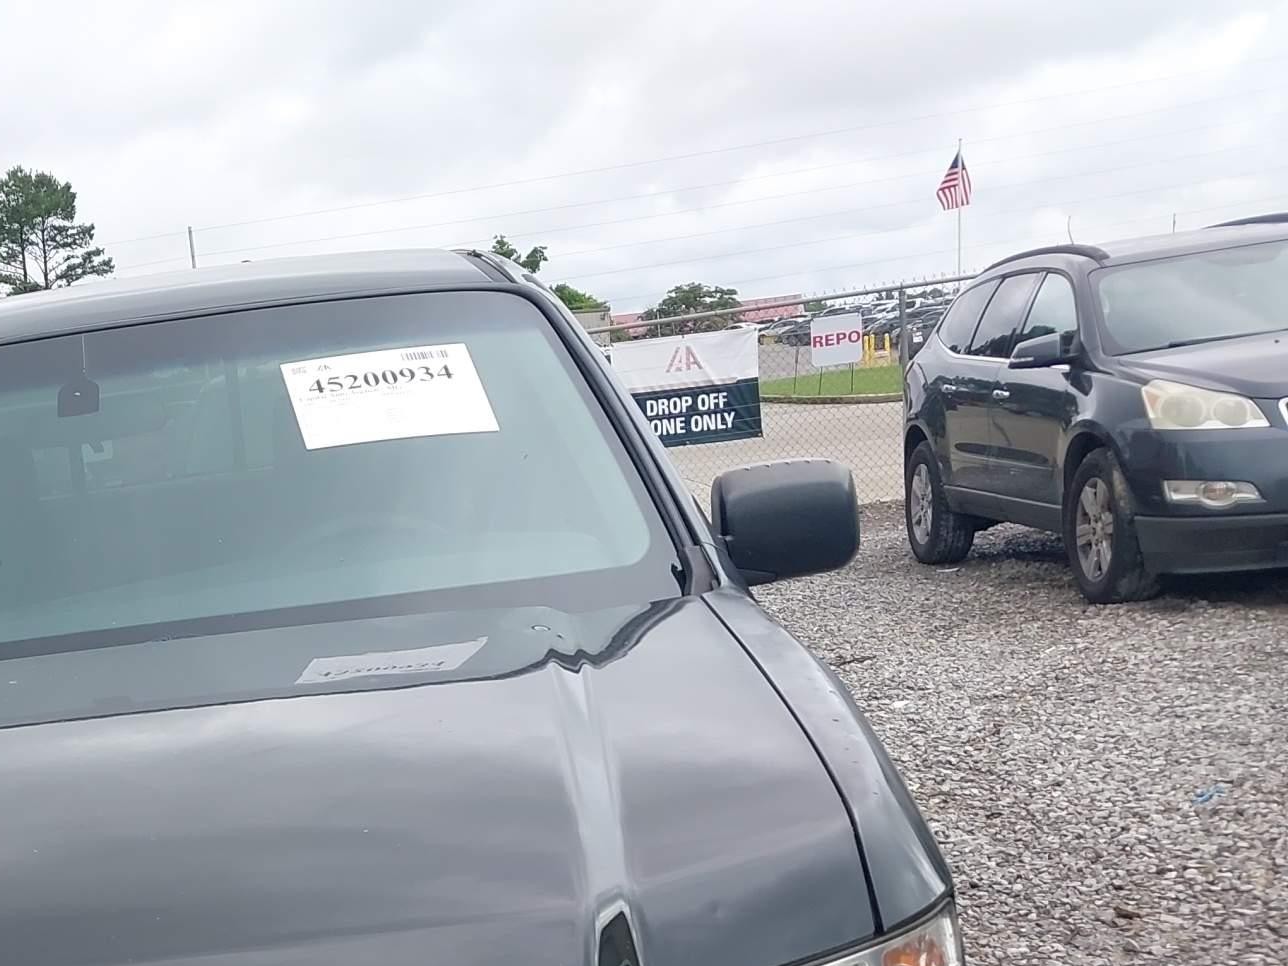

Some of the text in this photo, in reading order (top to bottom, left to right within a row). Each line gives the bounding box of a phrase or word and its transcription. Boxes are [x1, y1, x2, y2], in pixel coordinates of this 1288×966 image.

[812, 330, 861, 349] REPO
[308, 364, 455, 394] 45200934
[646, 391, 728, 417] DROP OFF
[649, 411, 736, 437] ONE ONLY
